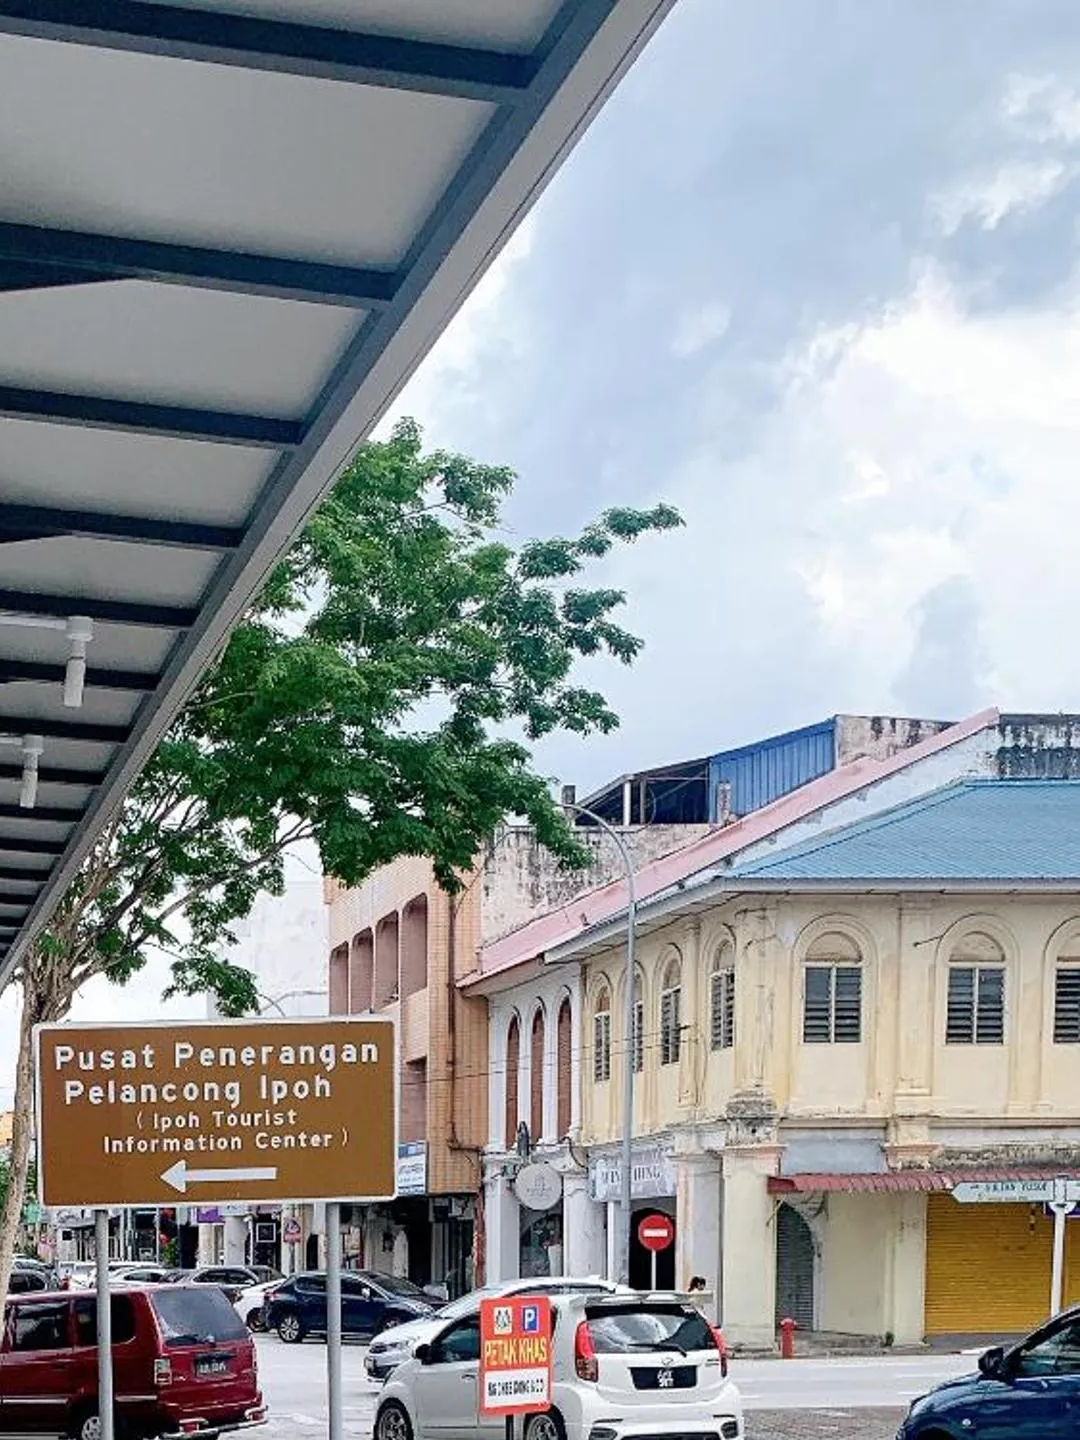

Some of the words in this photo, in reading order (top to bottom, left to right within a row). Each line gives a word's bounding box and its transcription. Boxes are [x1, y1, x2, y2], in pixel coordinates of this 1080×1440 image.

[54, 1044, 155, 1070] Pusat
[174, 1042, 379, 1072] Penerangan
[64, 1079, 240, 1108] Pelancong
[260, 1074, 332, 1104] Ipoh
[212, 1109, 298, 1128] Tourist
[104, 1135, 242, 1153] Information
[255, 1132, 332, 1149] Center
[485, 1339, 518, 1368] PETAK
[518, 1336, 548, 1364] KHAS
